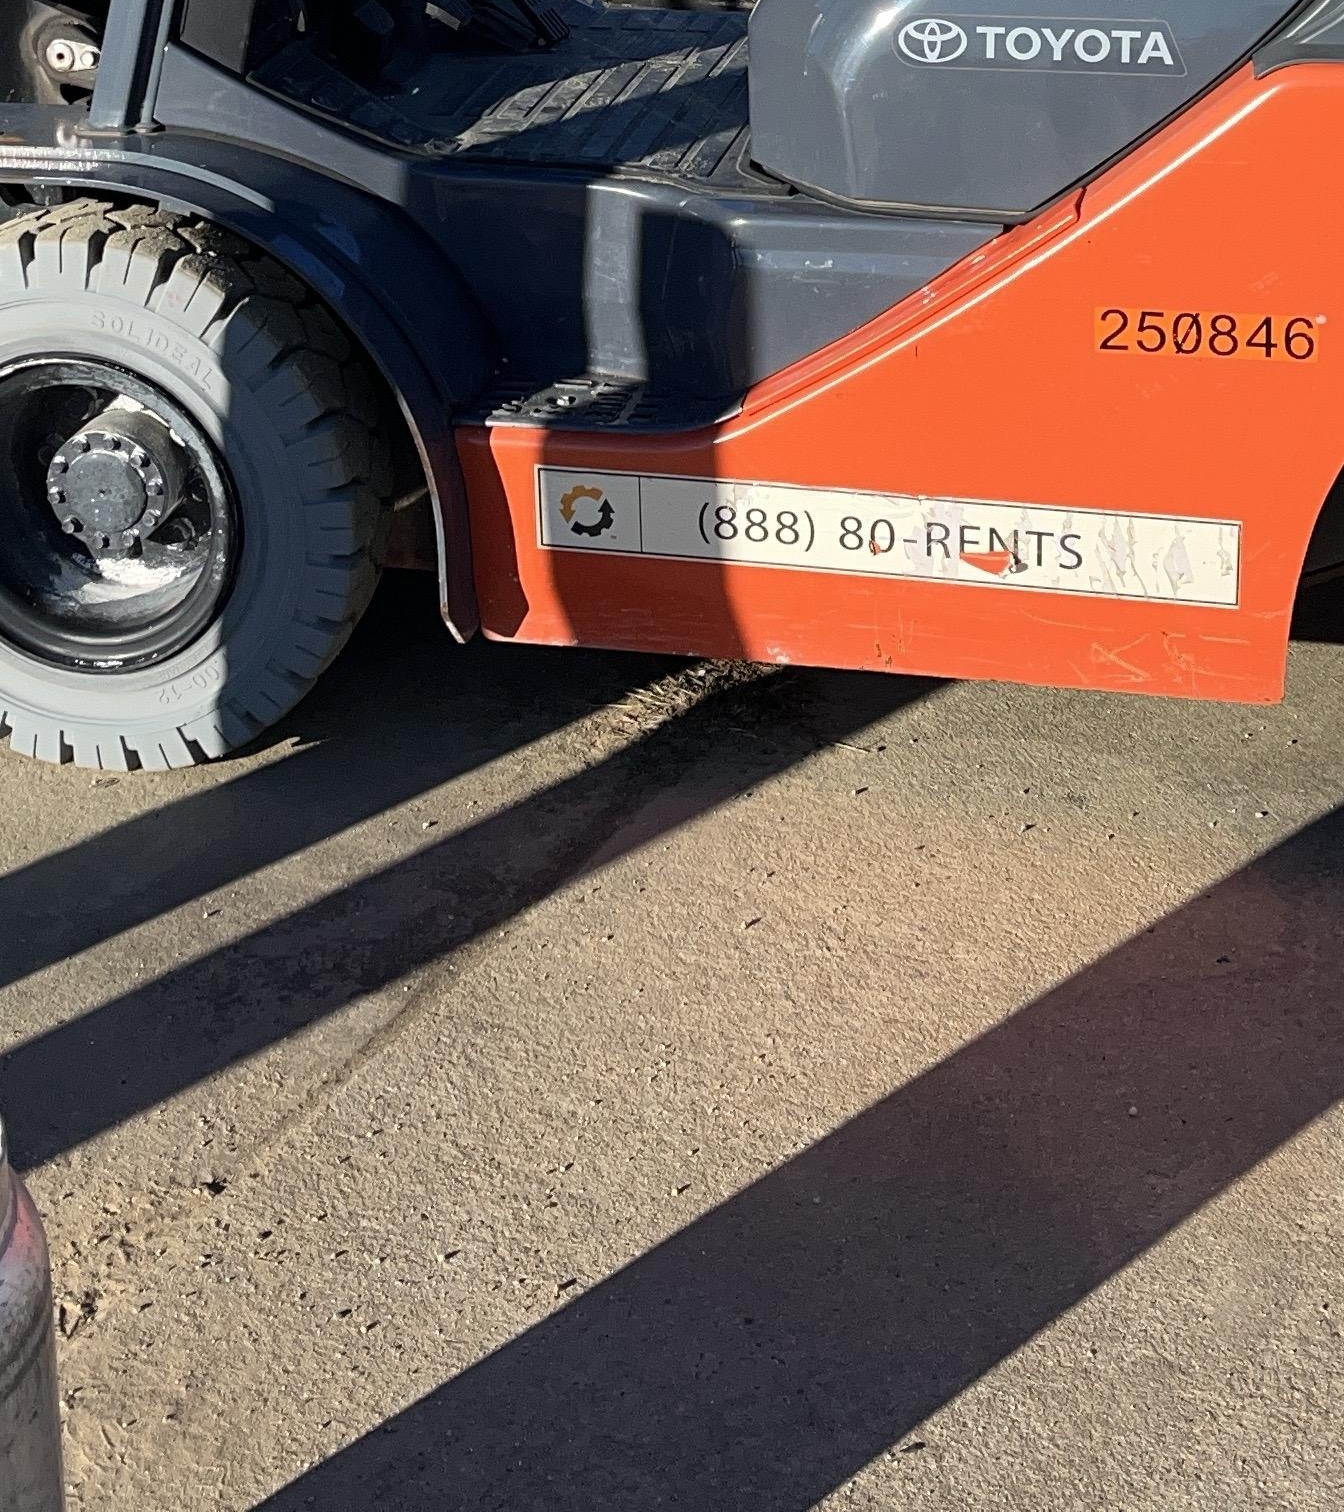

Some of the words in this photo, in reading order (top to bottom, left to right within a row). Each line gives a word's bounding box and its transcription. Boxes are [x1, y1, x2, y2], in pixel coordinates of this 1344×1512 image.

[976, 25, 1174, 65] TOYOTA
[1098, 308, 1315, 361] 250846
[698, 501, 816, 553] (888)
[839, 515, 1084, 571] 80-RENTS
